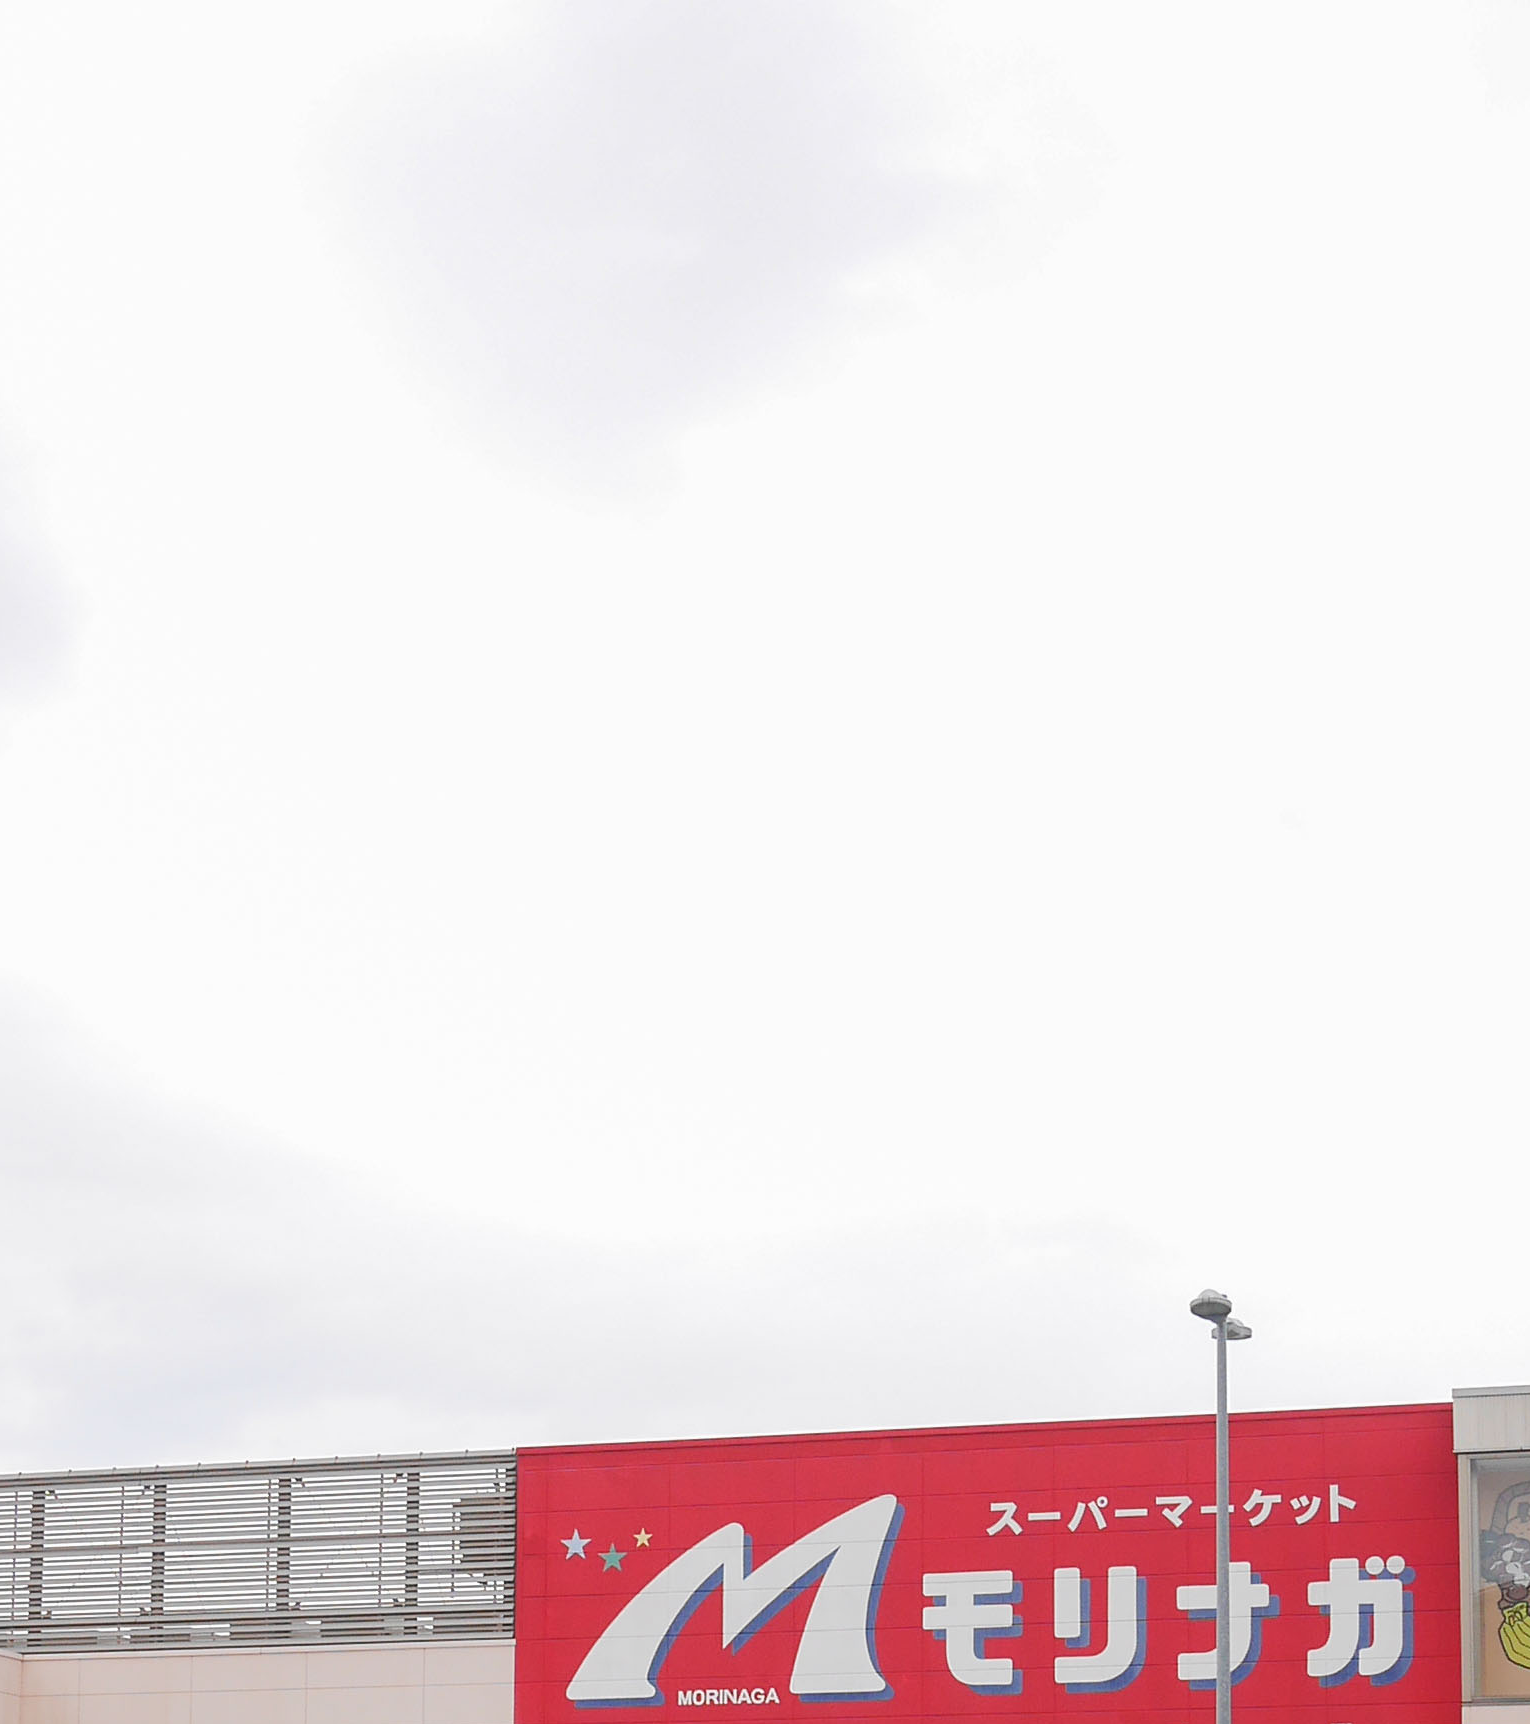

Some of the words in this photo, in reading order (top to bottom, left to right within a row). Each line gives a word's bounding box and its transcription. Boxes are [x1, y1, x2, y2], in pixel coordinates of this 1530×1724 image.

[985, 1484, 1357, 1537] スーパーマーケット
[921, 1555, 1415, 1696] モリナガ
[677, 1687, 780, 1707] MORINAGA
